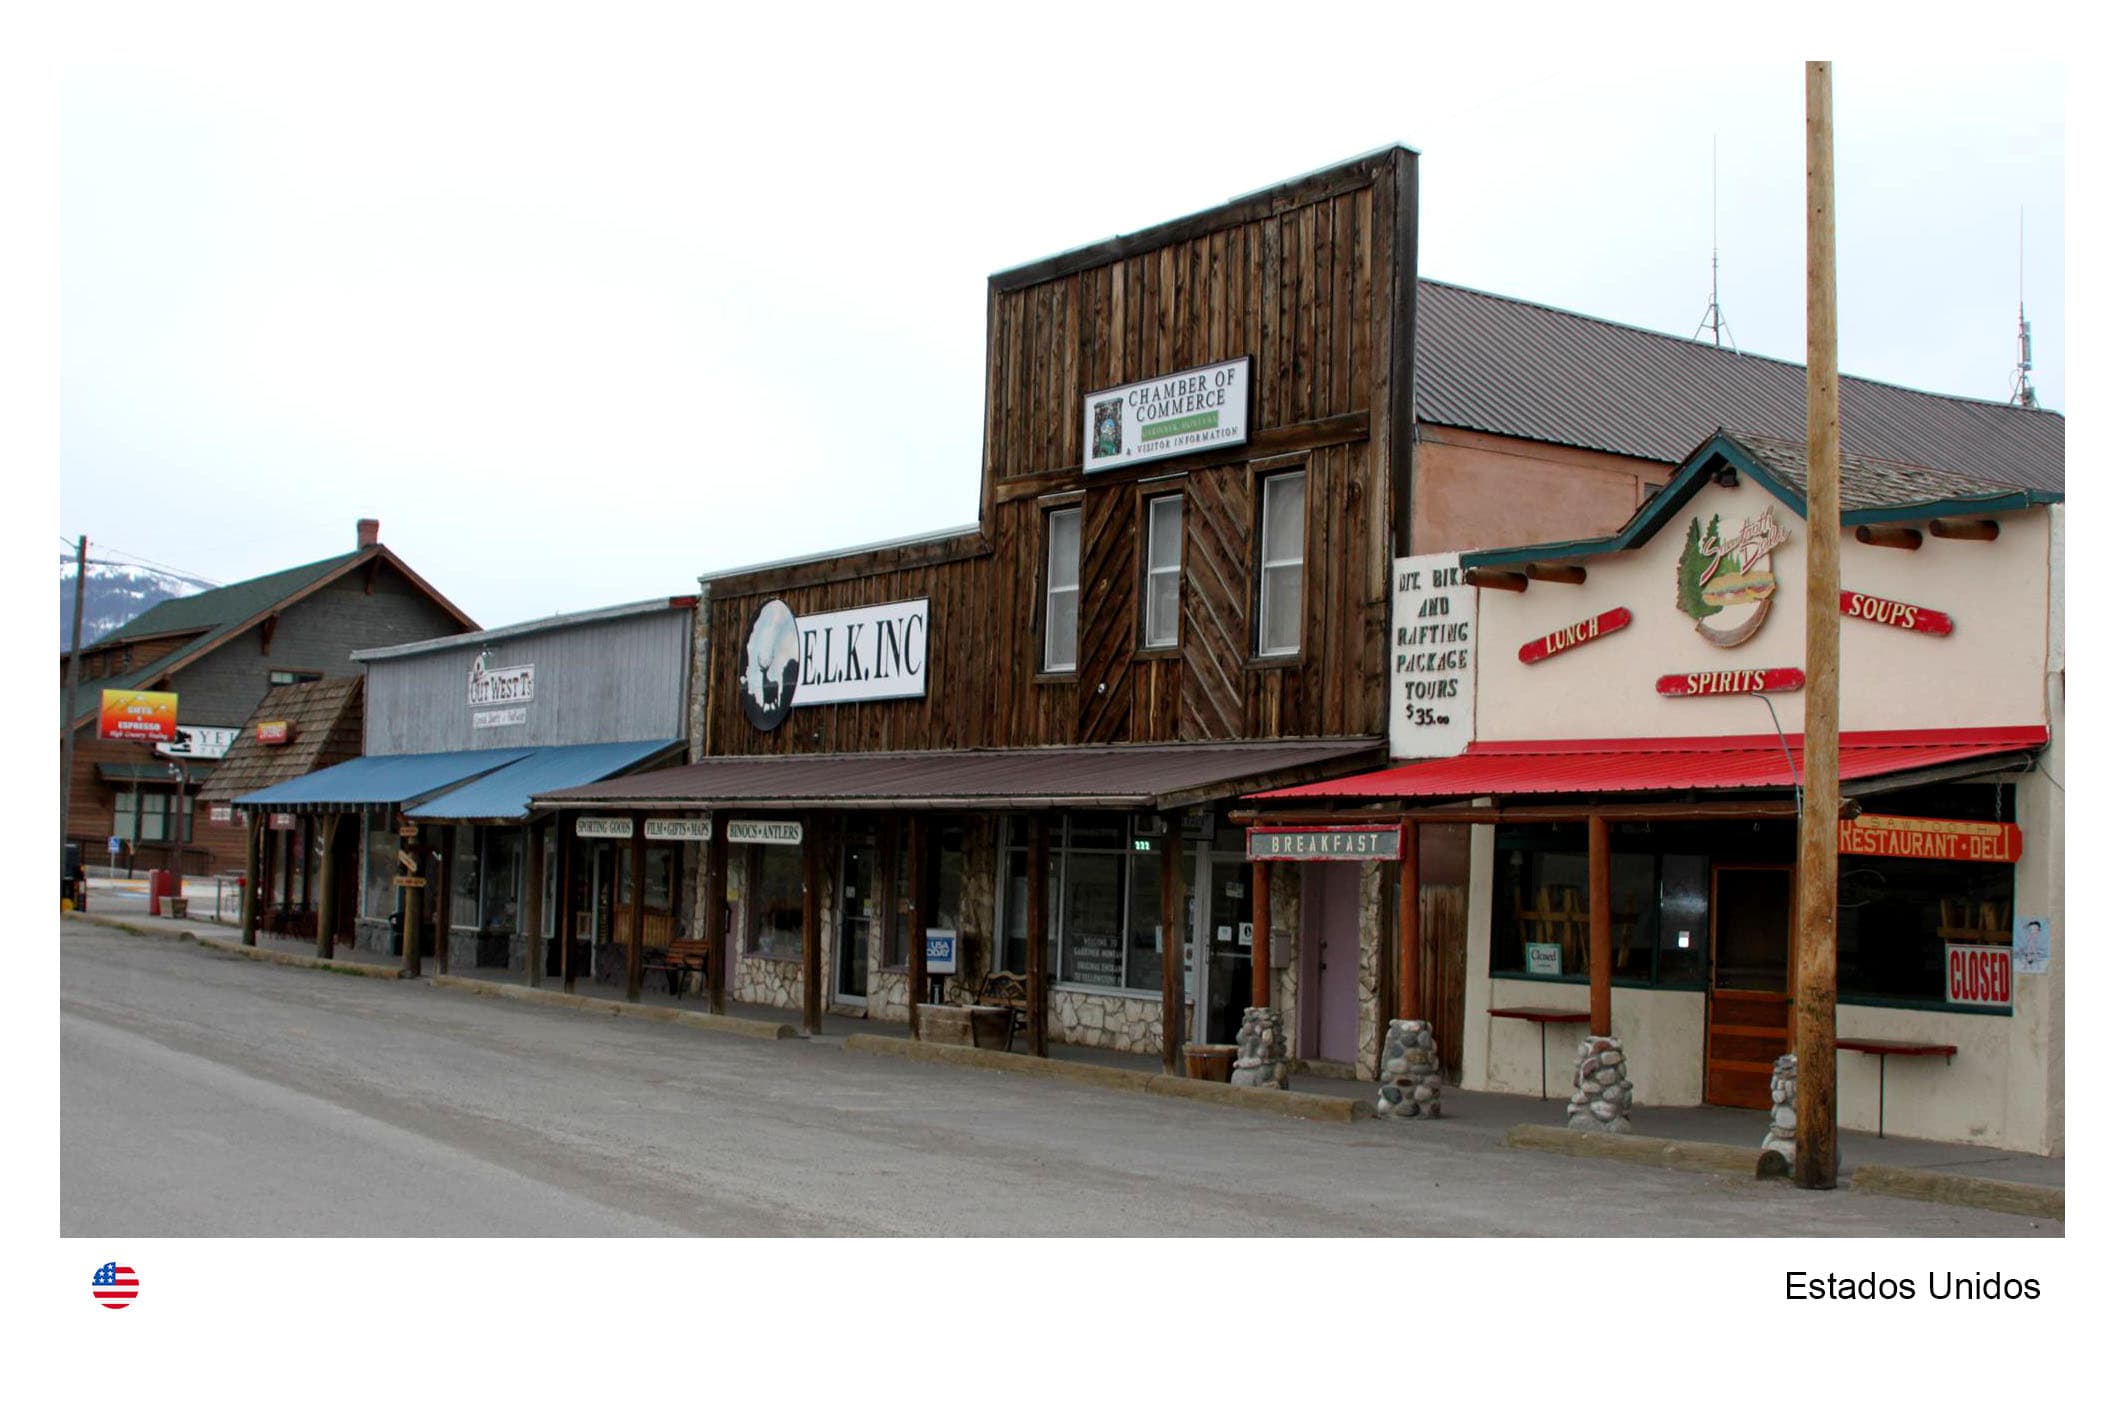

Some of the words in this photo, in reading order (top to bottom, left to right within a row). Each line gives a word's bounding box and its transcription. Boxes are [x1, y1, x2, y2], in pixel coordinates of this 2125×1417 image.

[1128, 374, 1208, 407] CHAMBER
[1214, 368, 1236, 388] OF
[1136, 388, 1226, 422] COMMERCE
[1136, 440, 1171, 454] VISITOR
[1174, 425, 1239, 447] INFORMATION
[1418, 596, 1450, 618] AND
[1848, 594, 1919, 629] SOUPS
[1397, 622, 1469, 646] RAFTING
[1545, 616, 1599, 654] LUNCH
[1396, 649, 1468, 673] PACKAGE
[490, 676, 520, 700] WEST
[1405, 678, 1459, 700] TOURS
[1686, 670, 1766, 694] SPIRITS
[118, 720, 161, 731] ESPRESSO
[577, 821, 608, 832] SPORTING
[609, 821, 631, 833] GOODS
[729, 823, 758, 837] BINOCS
[762, 824, 800, 840] ANTLERS
[1870, 817, 1989, 835] SAWTOOTH
[1271, 833, 1378, 853] BREAKFAST
[1839, 819, 1959, 858] RESTAURANT
[1969, 825, 2010, 860] DELI
[926, 948, 949, 957] ODAY
[1950, 950, 2010, 1002] CLOSED
